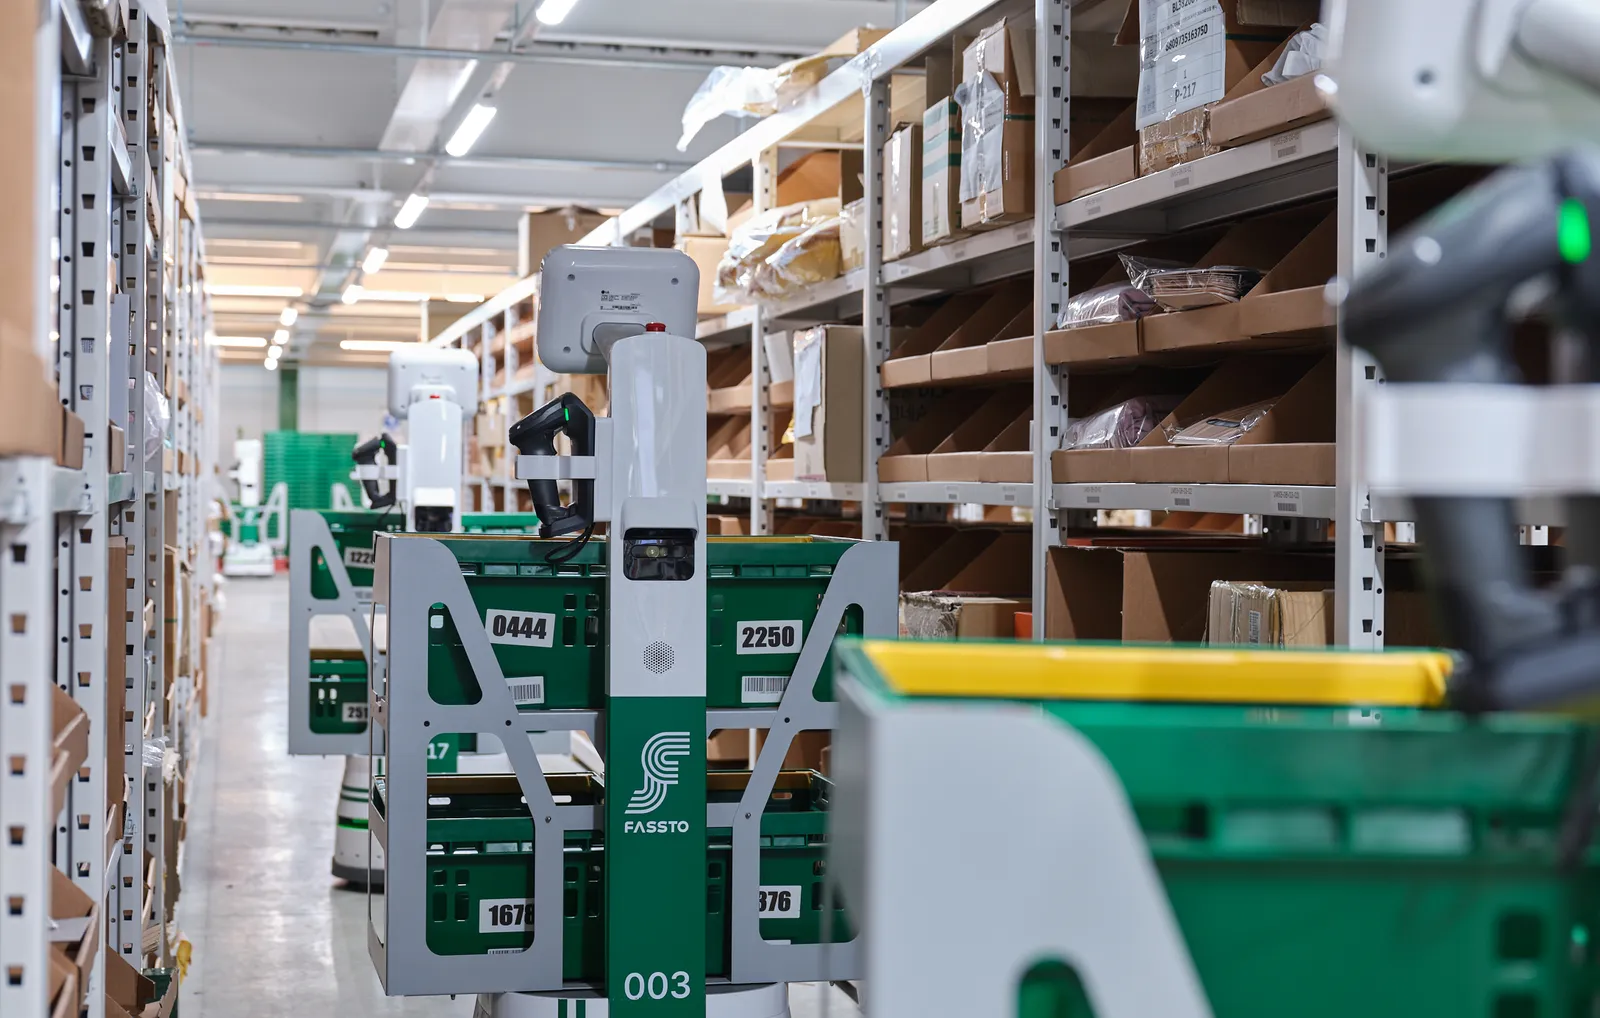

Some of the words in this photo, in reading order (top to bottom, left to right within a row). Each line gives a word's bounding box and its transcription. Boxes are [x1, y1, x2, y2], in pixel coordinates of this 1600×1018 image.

[1174, 81, 1197, 102] P-217
[492, 614, 547, 640] 0444
[742, 625, 795, 648] 2250
[624, 820, 690, 834] FASSTO
[488, 903, 535, 927] 1678
[624, 970, 691, 1001] 003
